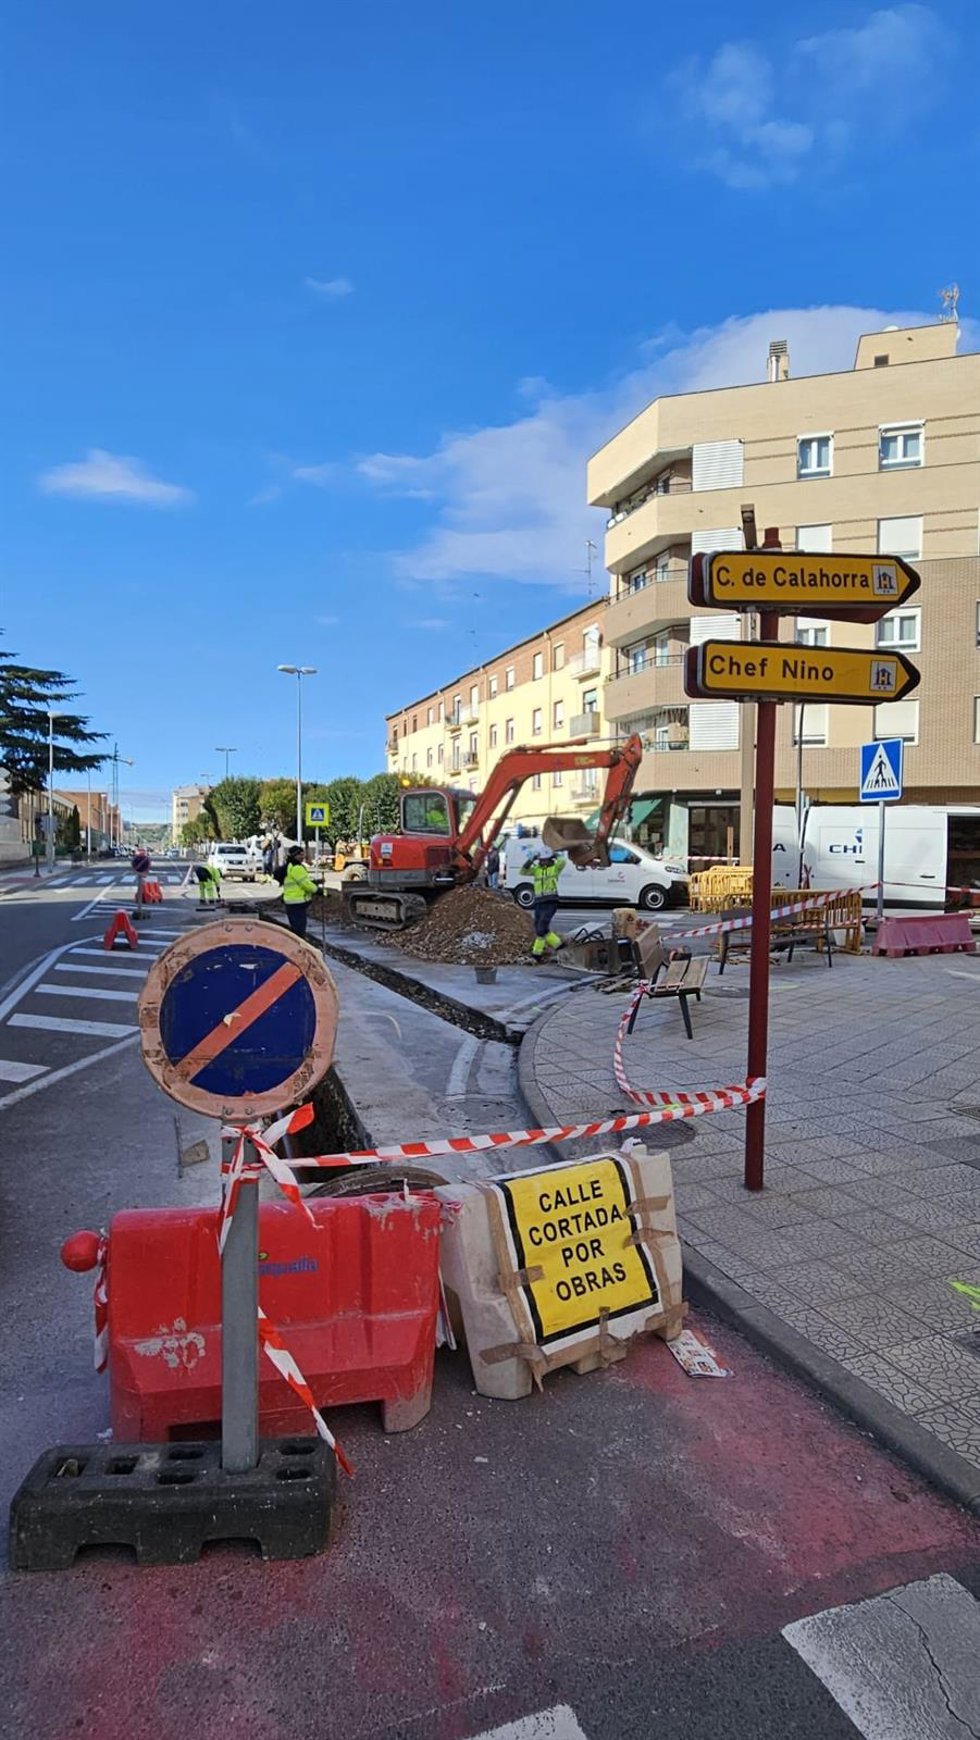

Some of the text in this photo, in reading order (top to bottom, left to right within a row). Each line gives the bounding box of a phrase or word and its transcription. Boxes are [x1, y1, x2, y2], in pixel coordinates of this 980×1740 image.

[716, 566, 870, 589] C. de Calahorra
[709, 655, 834, 682] Chef Nino
[539, 1179, 604, 1213] CALLE
[528, 1203, 623, 1247] CORTADA
[561, 1237, 605, 1268] POR
[556, 1262, 627, 1302] OBRAS
